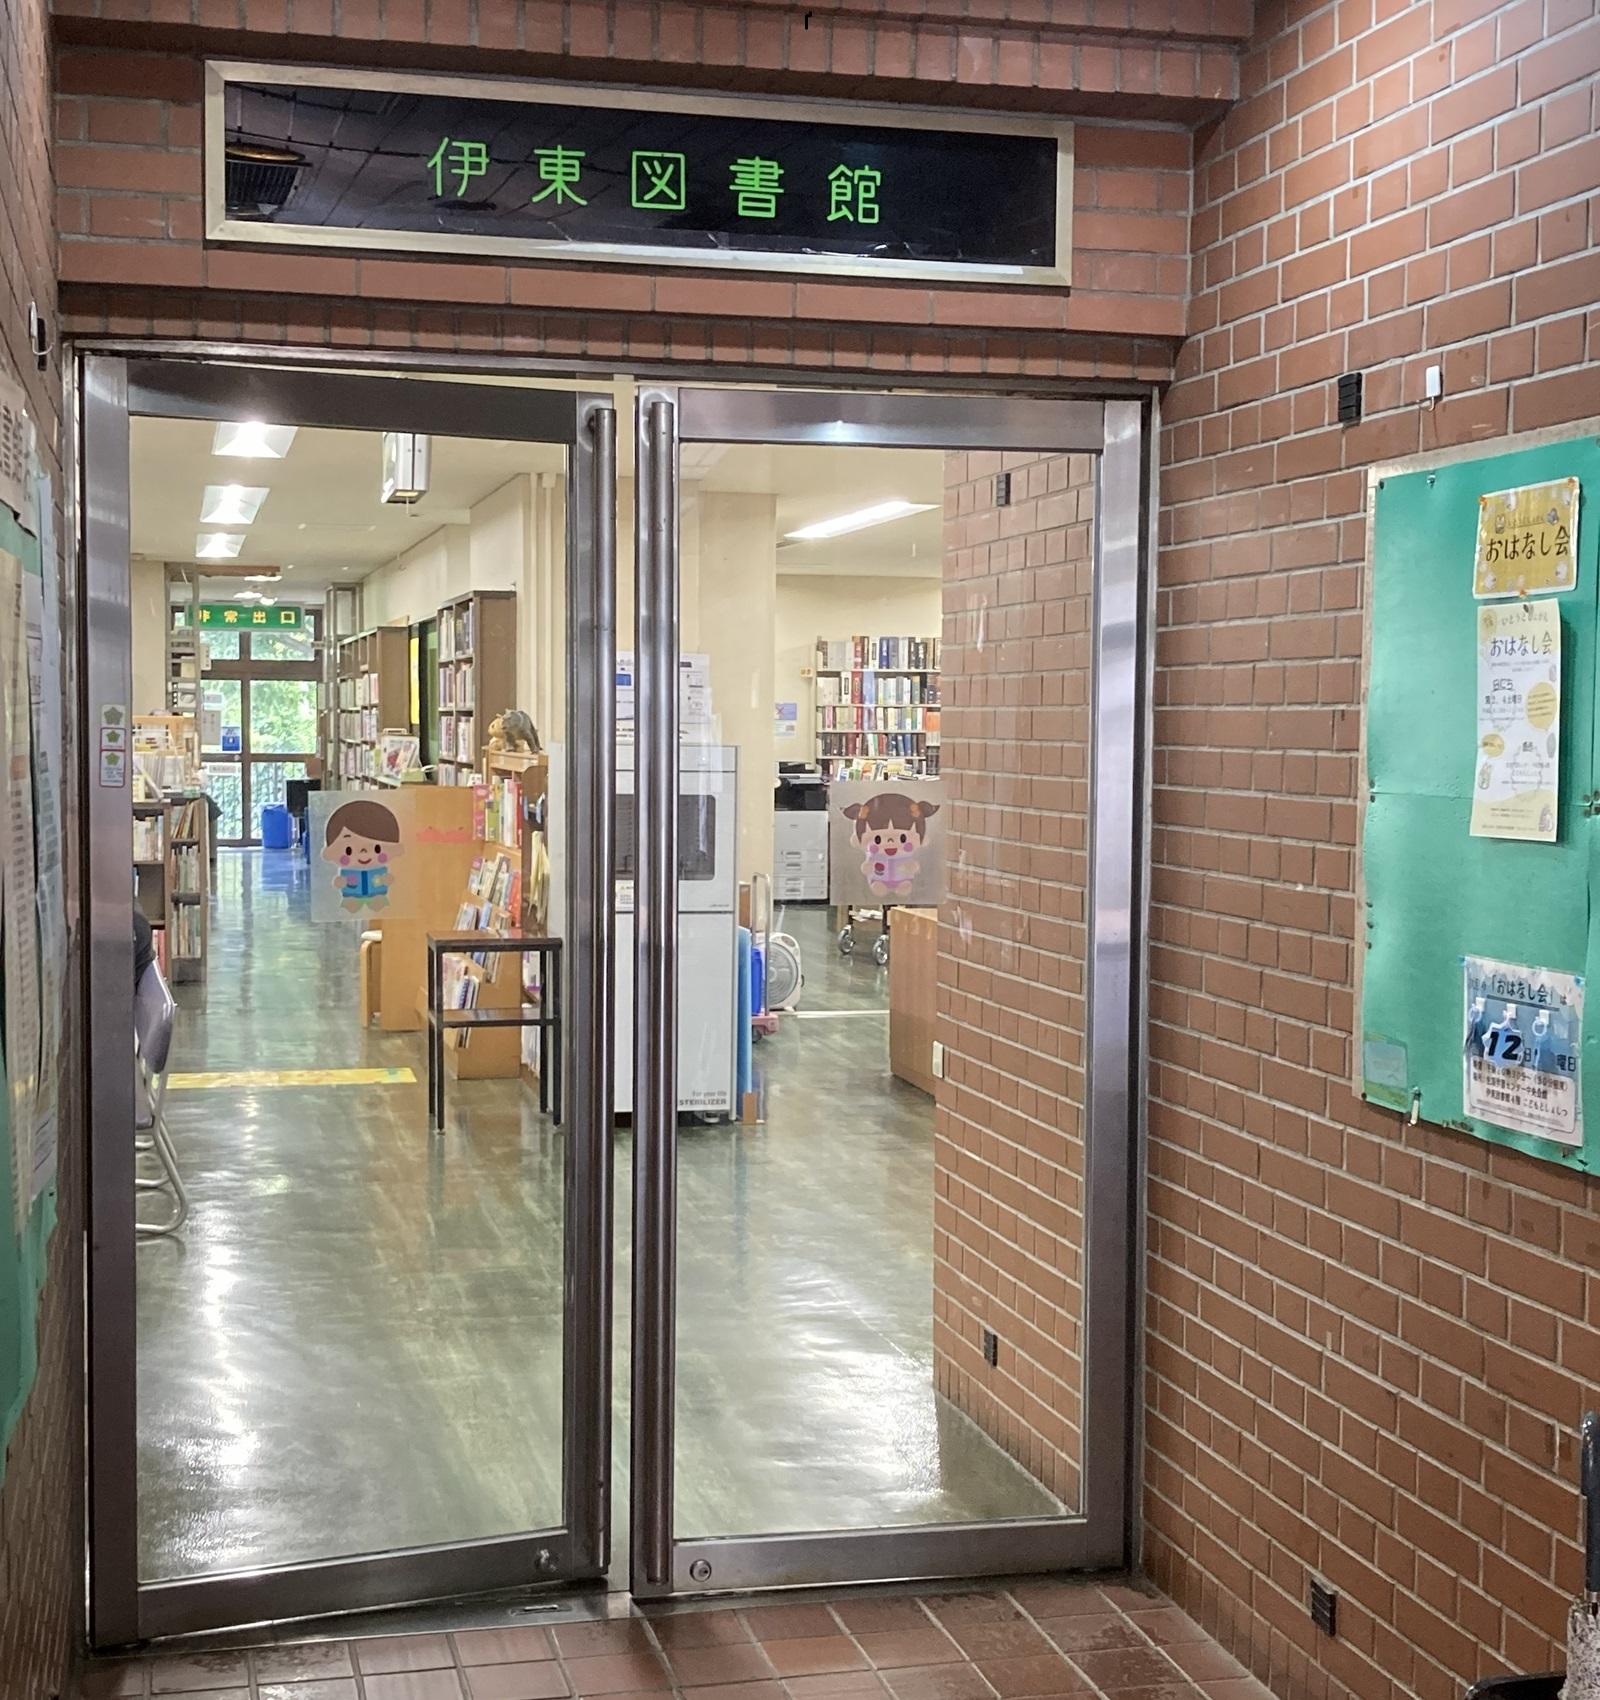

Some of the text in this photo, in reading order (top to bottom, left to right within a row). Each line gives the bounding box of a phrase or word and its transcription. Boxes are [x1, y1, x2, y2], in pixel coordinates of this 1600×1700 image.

[426, 136, 883, 226] 伊東図書館
[1486, 525, 1570, 563] おはなし会
[1490, 631, 1553, 657] おはなし会
